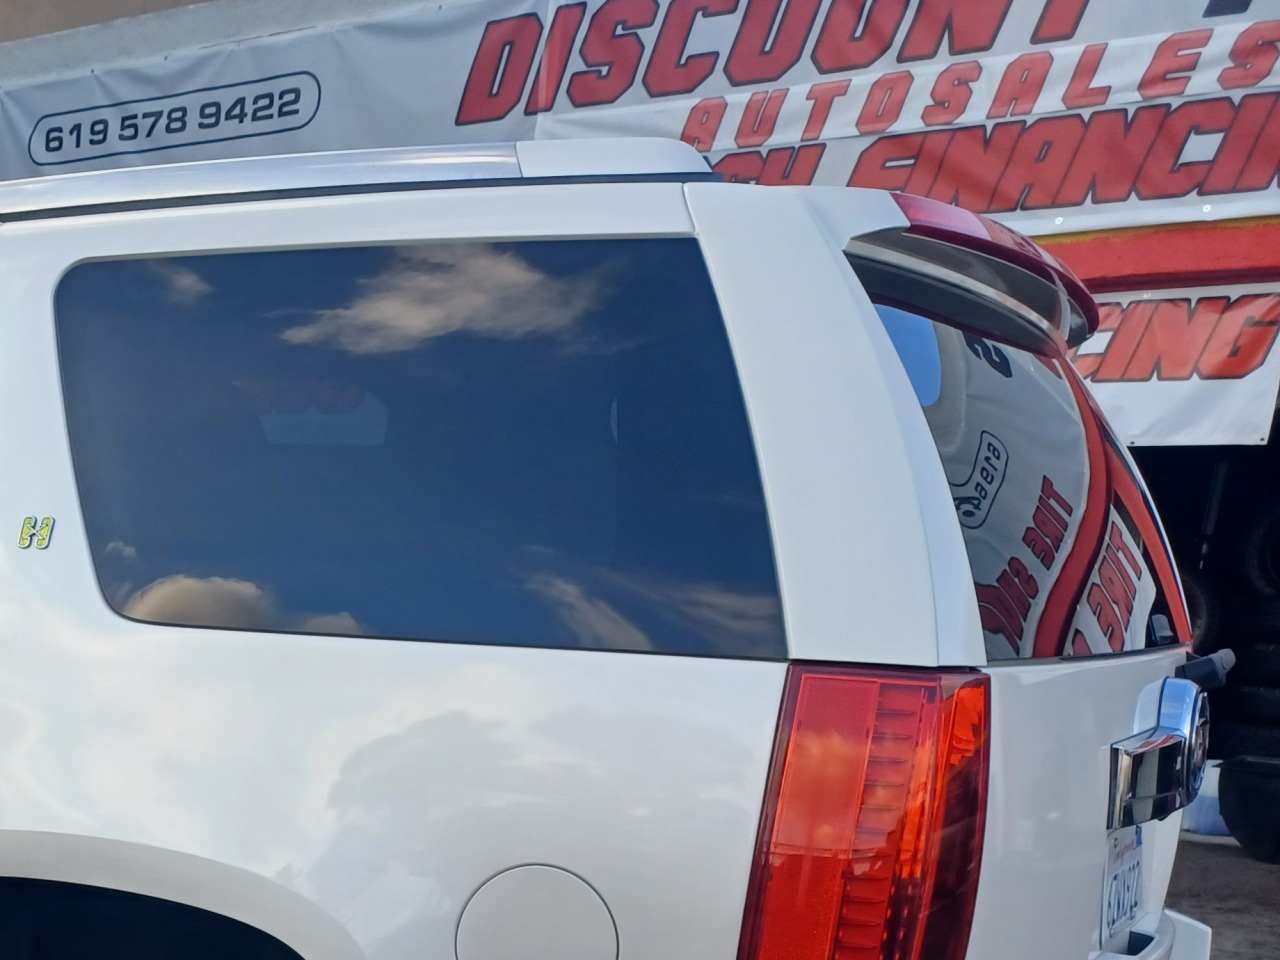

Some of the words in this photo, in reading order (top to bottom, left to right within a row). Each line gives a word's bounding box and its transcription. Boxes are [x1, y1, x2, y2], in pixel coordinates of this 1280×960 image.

[44, 119, 109, 153] 619
[117, 106, 188, 141] 578
[197, 87, 301, 130] 9422
